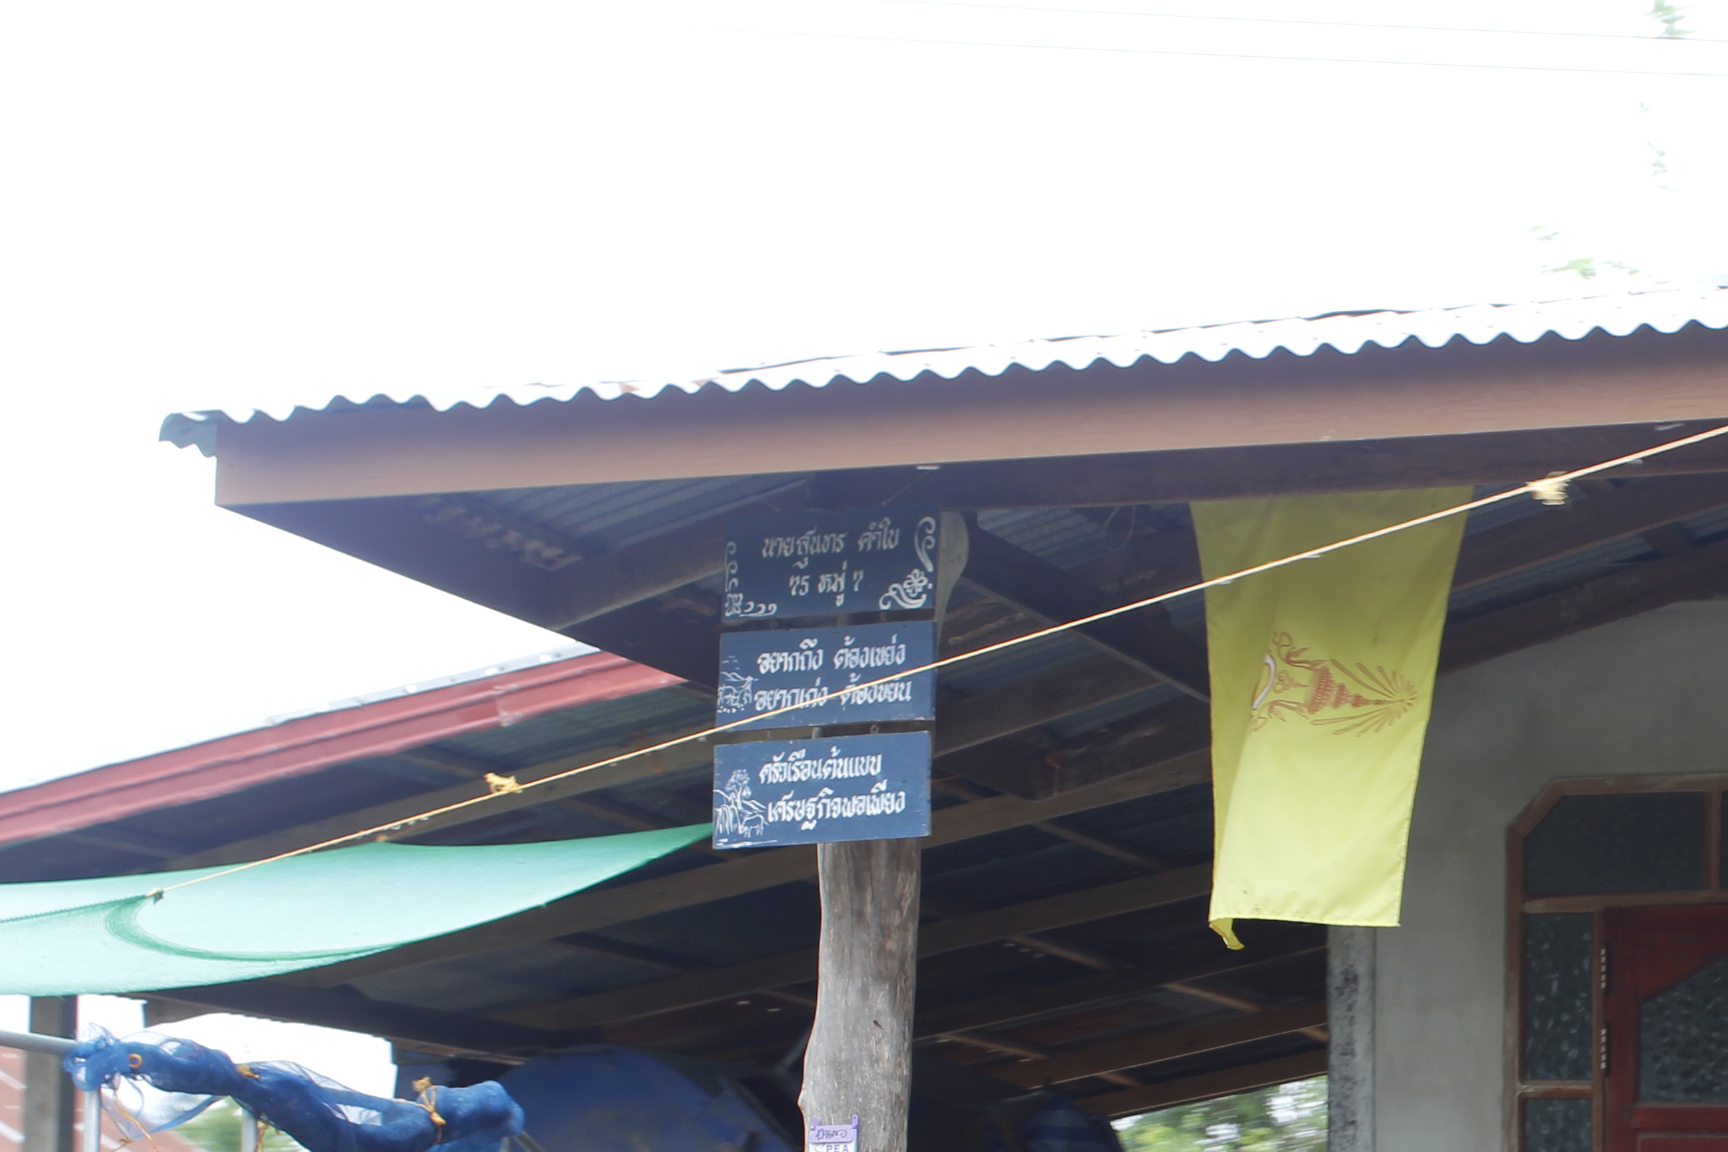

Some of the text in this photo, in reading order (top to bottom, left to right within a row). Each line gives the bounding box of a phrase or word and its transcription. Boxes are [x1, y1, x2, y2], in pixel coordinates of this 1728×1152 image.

[788, 559, 864, 607] 75 หมู่ 7
[756, 633, 907, 674] อยากถึง ต้องเขย่ง
[753, 676, 829, 712] อยากเก่ง
[758, 745, 883, 785] ครัวเรือนต้นแบบ
[767, 778, 906, 831] เศรษฐกิจพอเพียง
[826, 1144, 849, 1152] PEA
